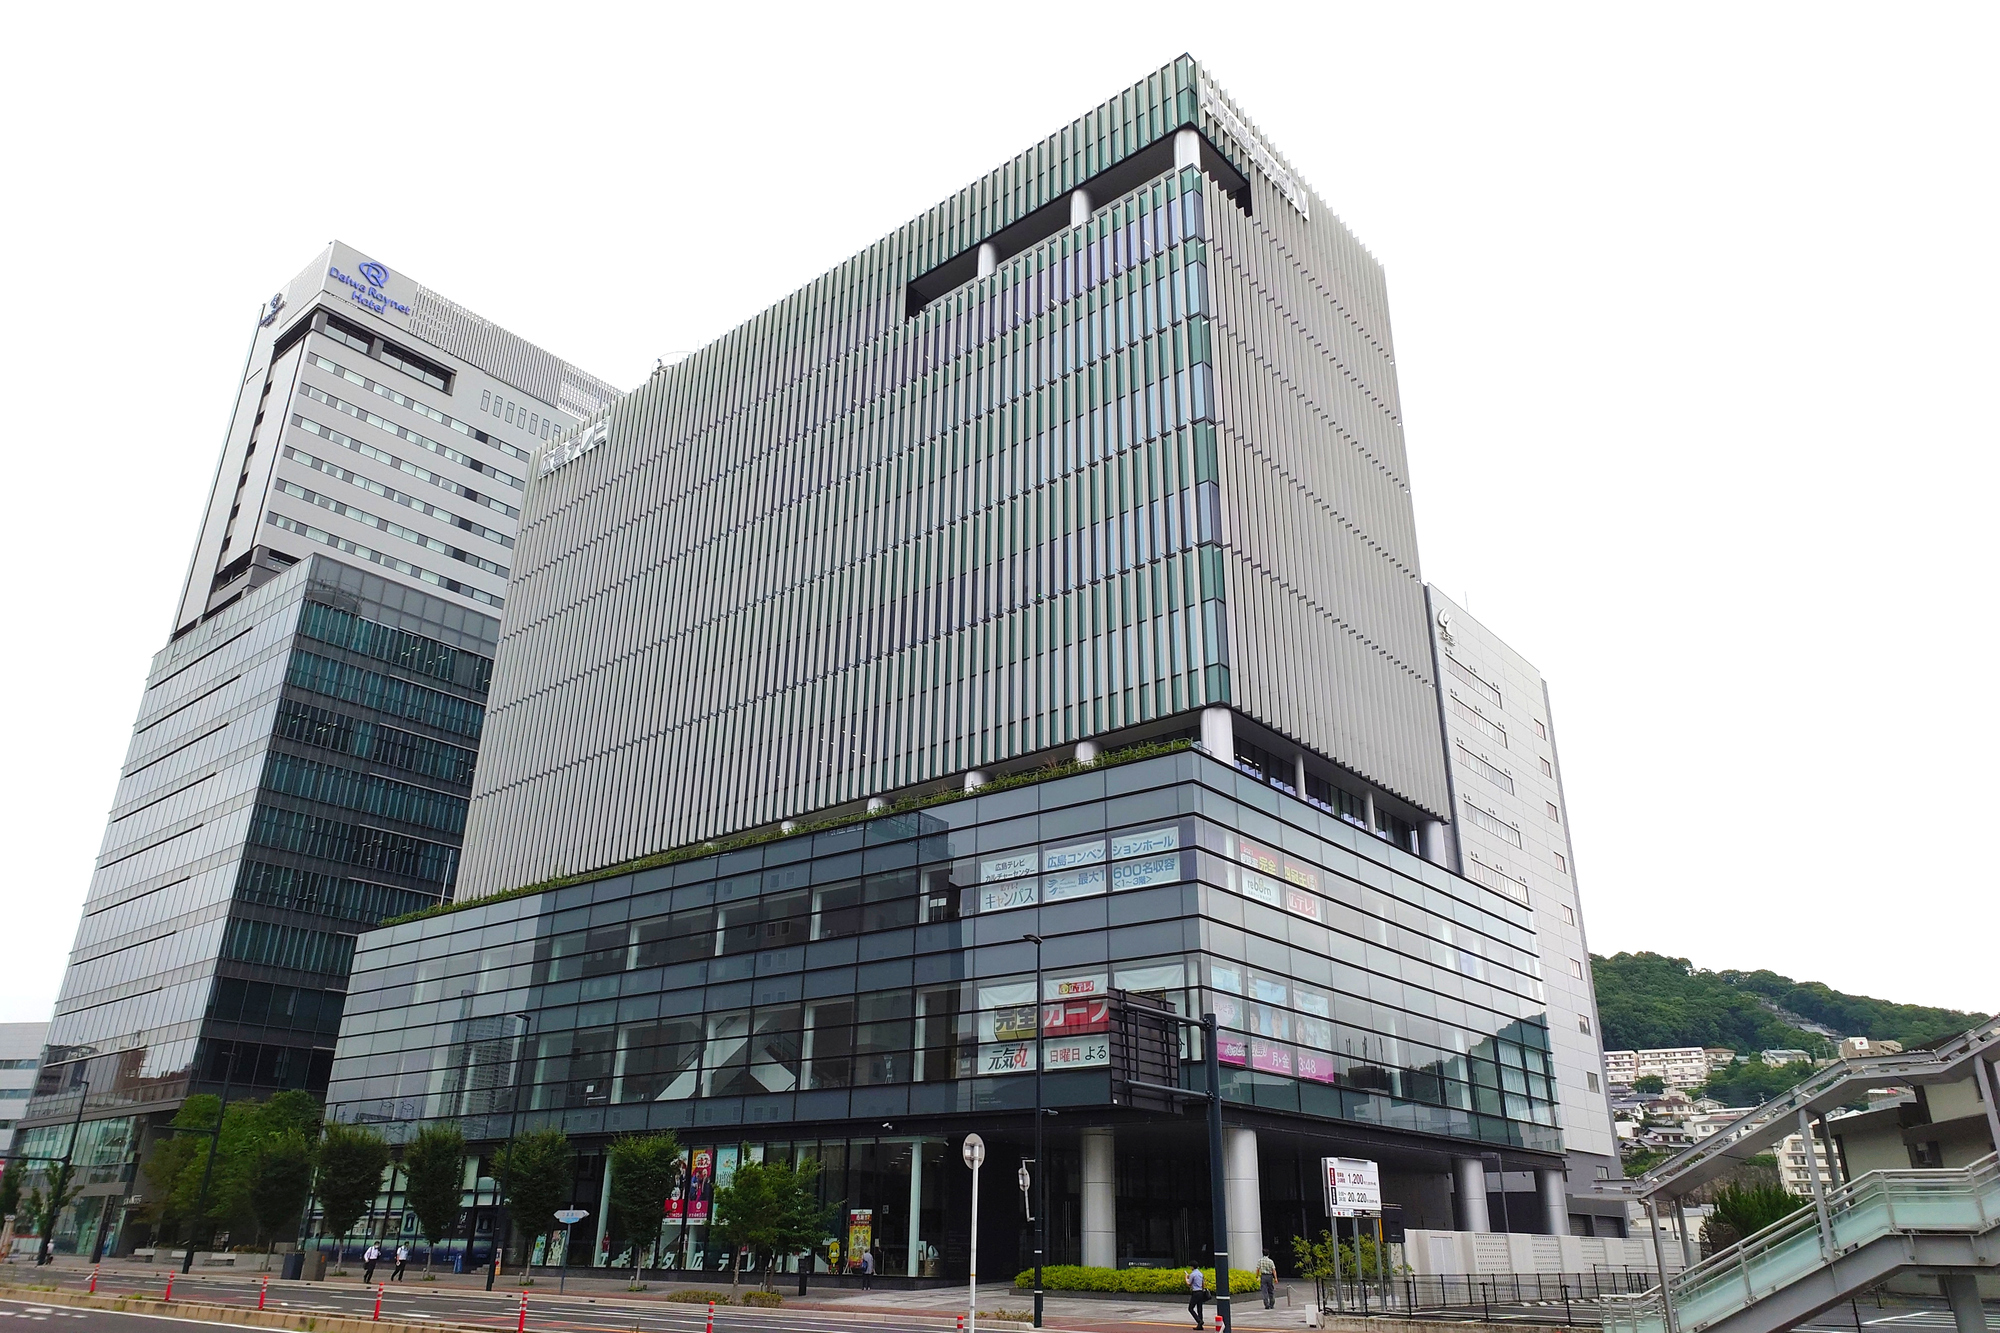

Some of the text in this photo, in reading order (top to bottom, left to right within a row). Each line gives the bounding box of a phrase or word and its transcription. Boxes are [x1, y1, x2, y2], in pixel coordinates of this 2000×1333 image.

[329, 266, 411, 315] Daiwa Roynet
[351, 290, 387, 315] Hotel
[994, 858, 1026, 871] 広島テレビ
[985, 887, 1035, 909] キャンパス
[988, 1043, 1028, 1071] 元気丸
[1050, 1045, 1107, 1064] 日曜日 よる
[1347, 1173, 1364, 1186] 1,200
